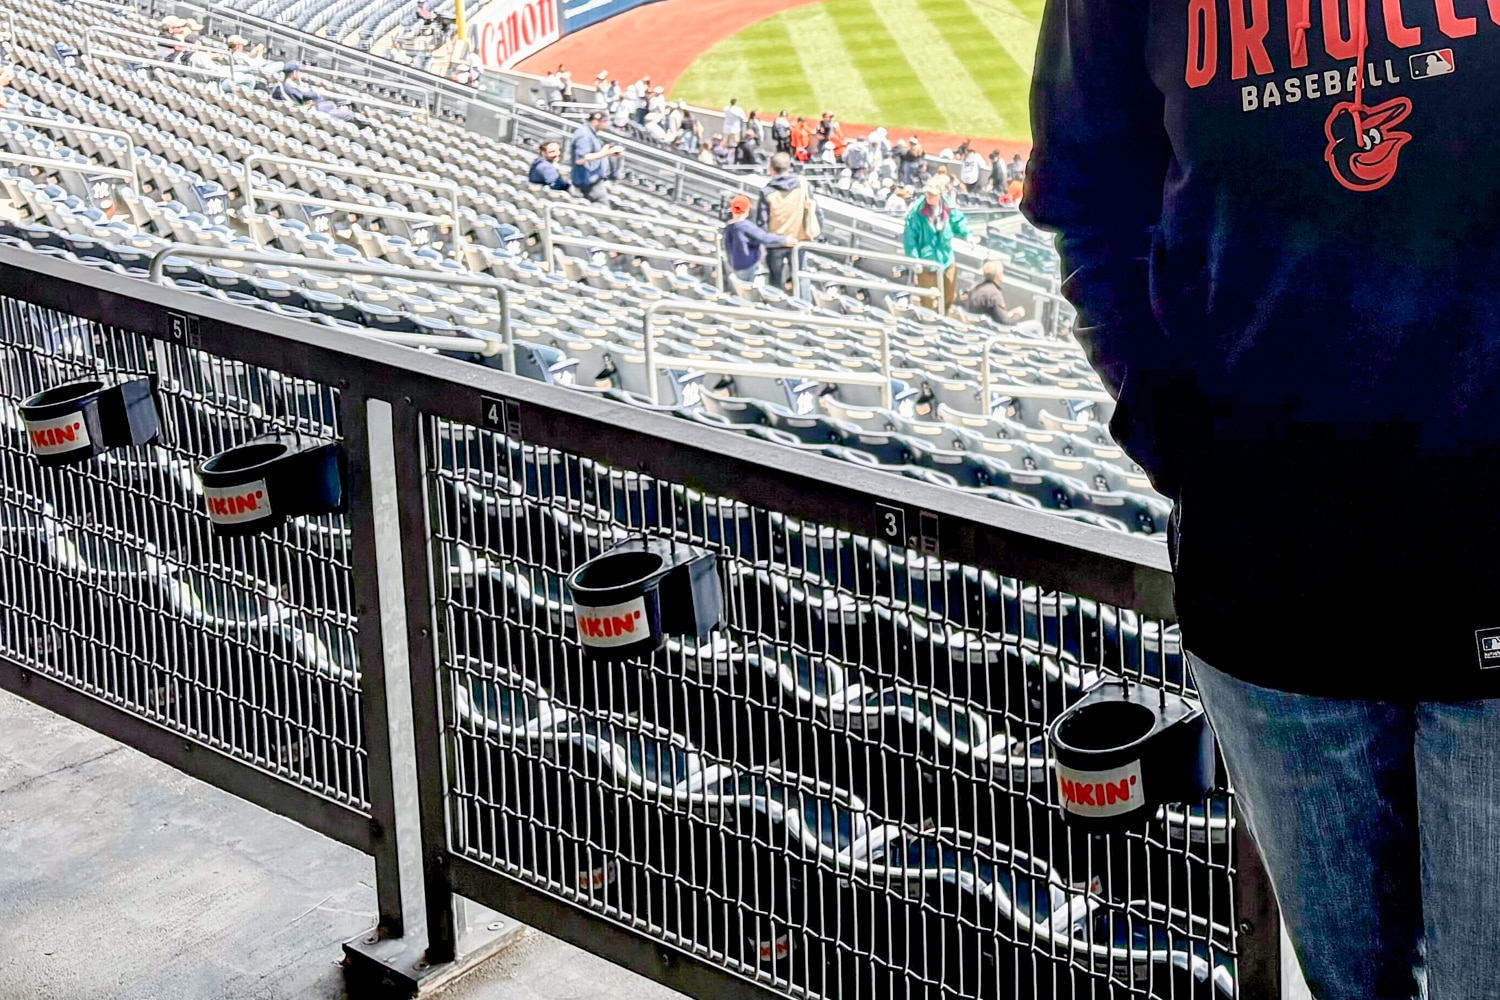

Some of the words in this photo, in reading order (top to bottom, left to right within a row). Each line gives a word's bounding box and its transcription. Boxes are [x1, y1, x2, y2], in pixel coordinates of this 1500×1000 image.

[1241, 59, 1400, 112] BASEBALL
[174, 319, 181, 338] 5
[488, 404, 499, 424] 4
[208, 490, 263, 515] KIN'
[885, 512, 897, 537] 3
